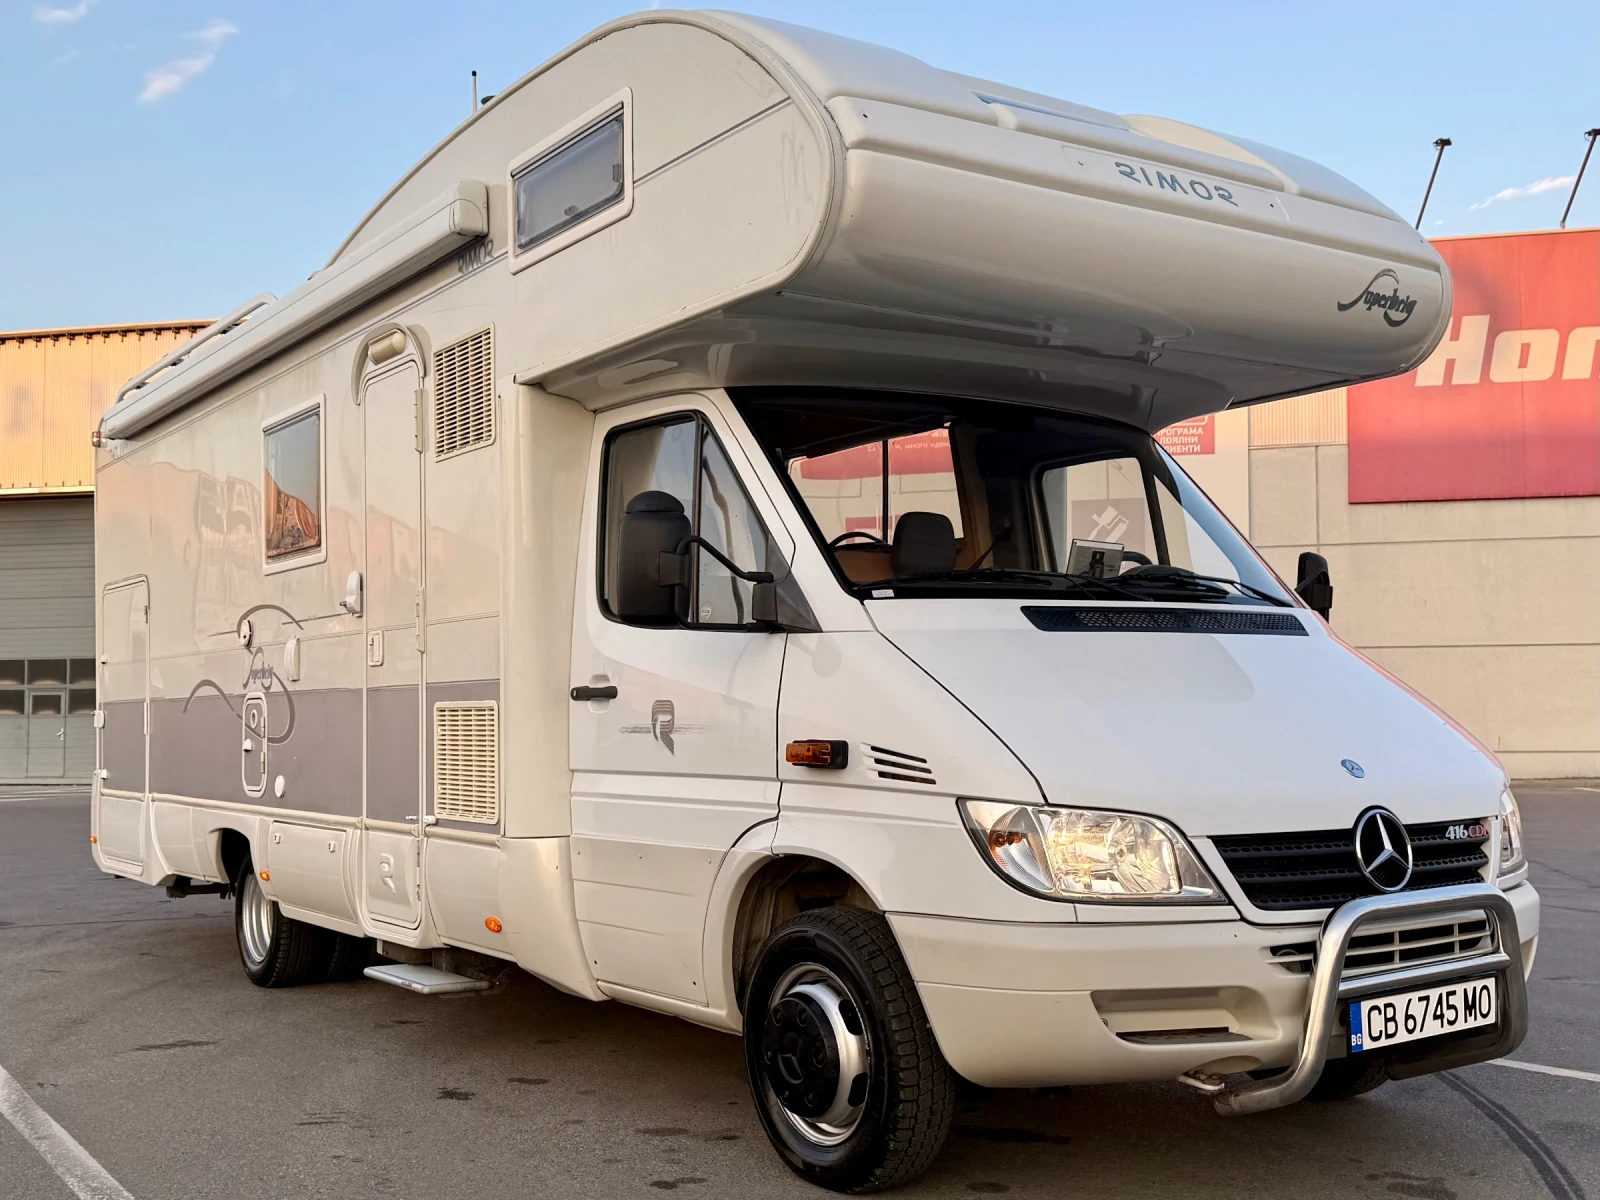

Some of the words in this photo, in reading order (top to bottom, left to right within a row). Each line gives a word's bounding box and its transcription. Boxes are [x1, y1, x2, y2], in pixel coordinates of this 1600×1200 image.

[1157, 427, 1204, 436] РОГРАМА
[1164, 444, 1200, 453] ЛИЕНТИ
[1445, 825, 1468, 840] 416
[1367, 1002, 1398, 1043] CB
[1404, 990, 1459, 1035] 6745
[1463, 984, 1492, 1024] MO
[1351, 1034, 1362, 1046] BG
